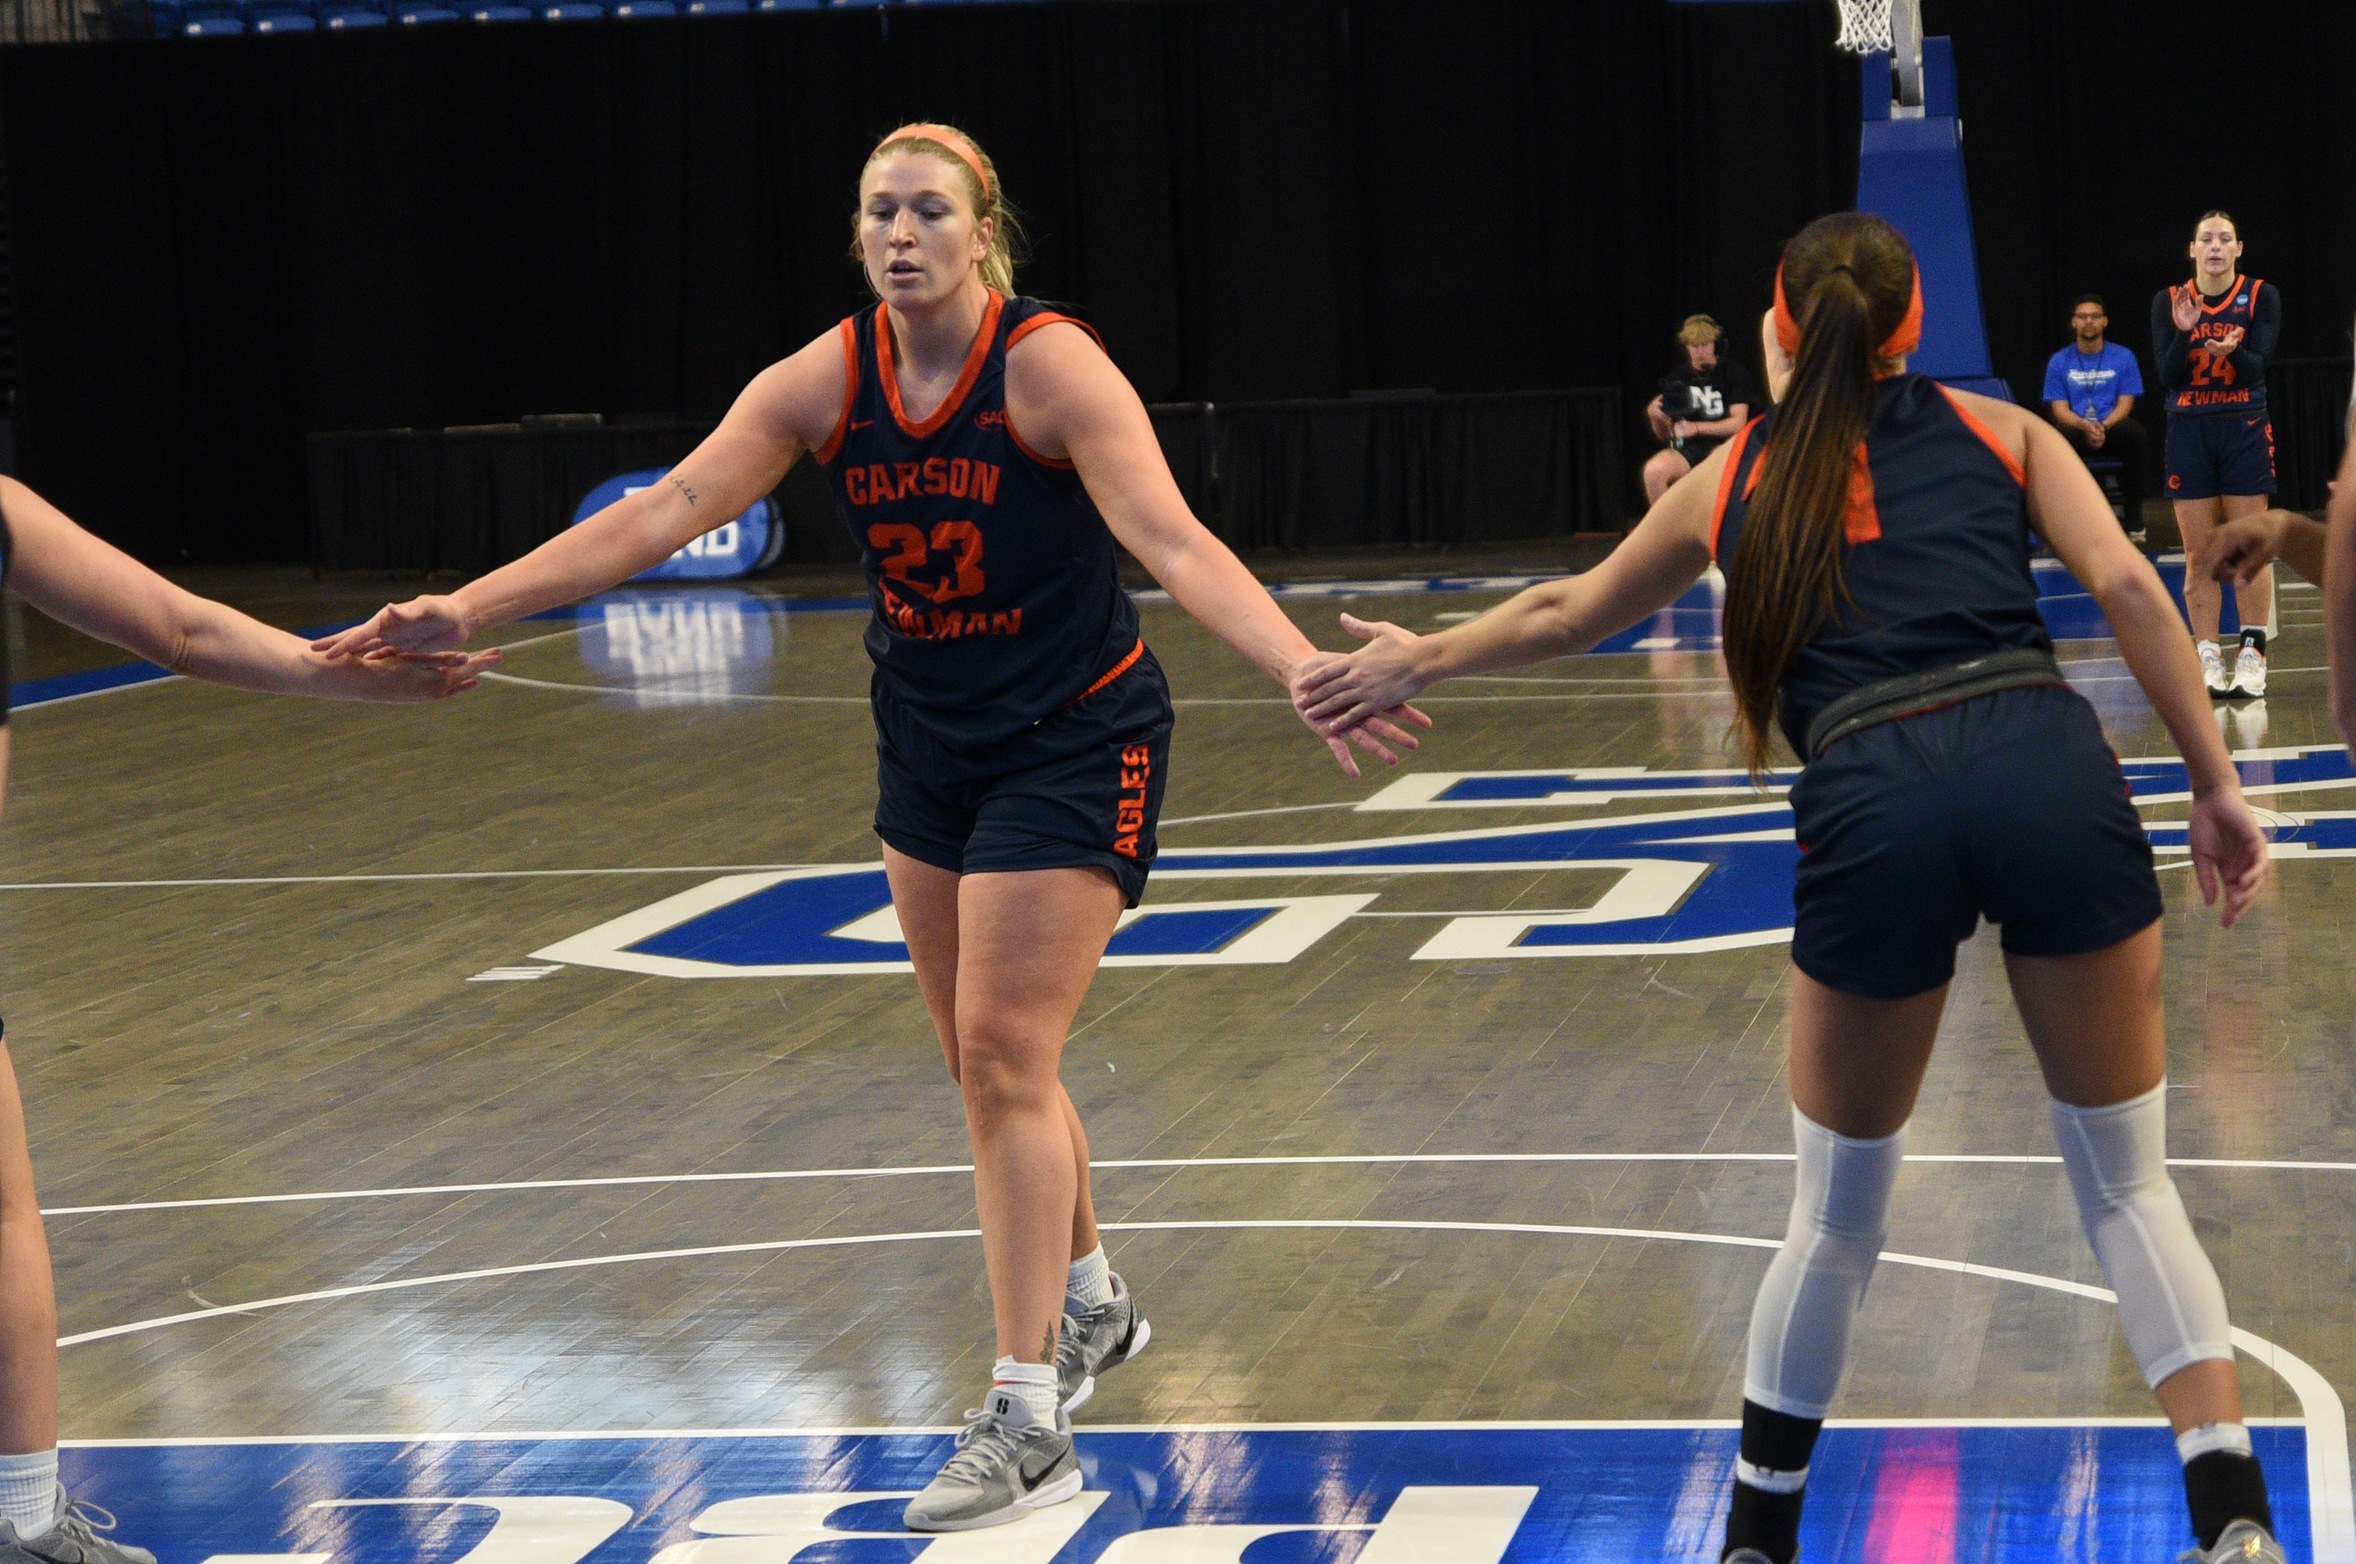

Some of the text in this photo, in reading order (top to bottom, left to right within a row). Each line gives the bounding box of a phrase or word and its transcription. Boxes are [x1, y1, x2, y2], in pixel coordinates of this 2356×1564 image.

[2191, 321, 2247, 342] ARSO
[2188, 348, 2237, 386] 24
[1689, 385, 1725, 415] NG
[2176, 387, 2250, 407] NEWMAN
[845, 456, 1001, 506] CARSON
[867, 520, 985, 604] 23
[1113, 744, 1151, 858] AGLES
